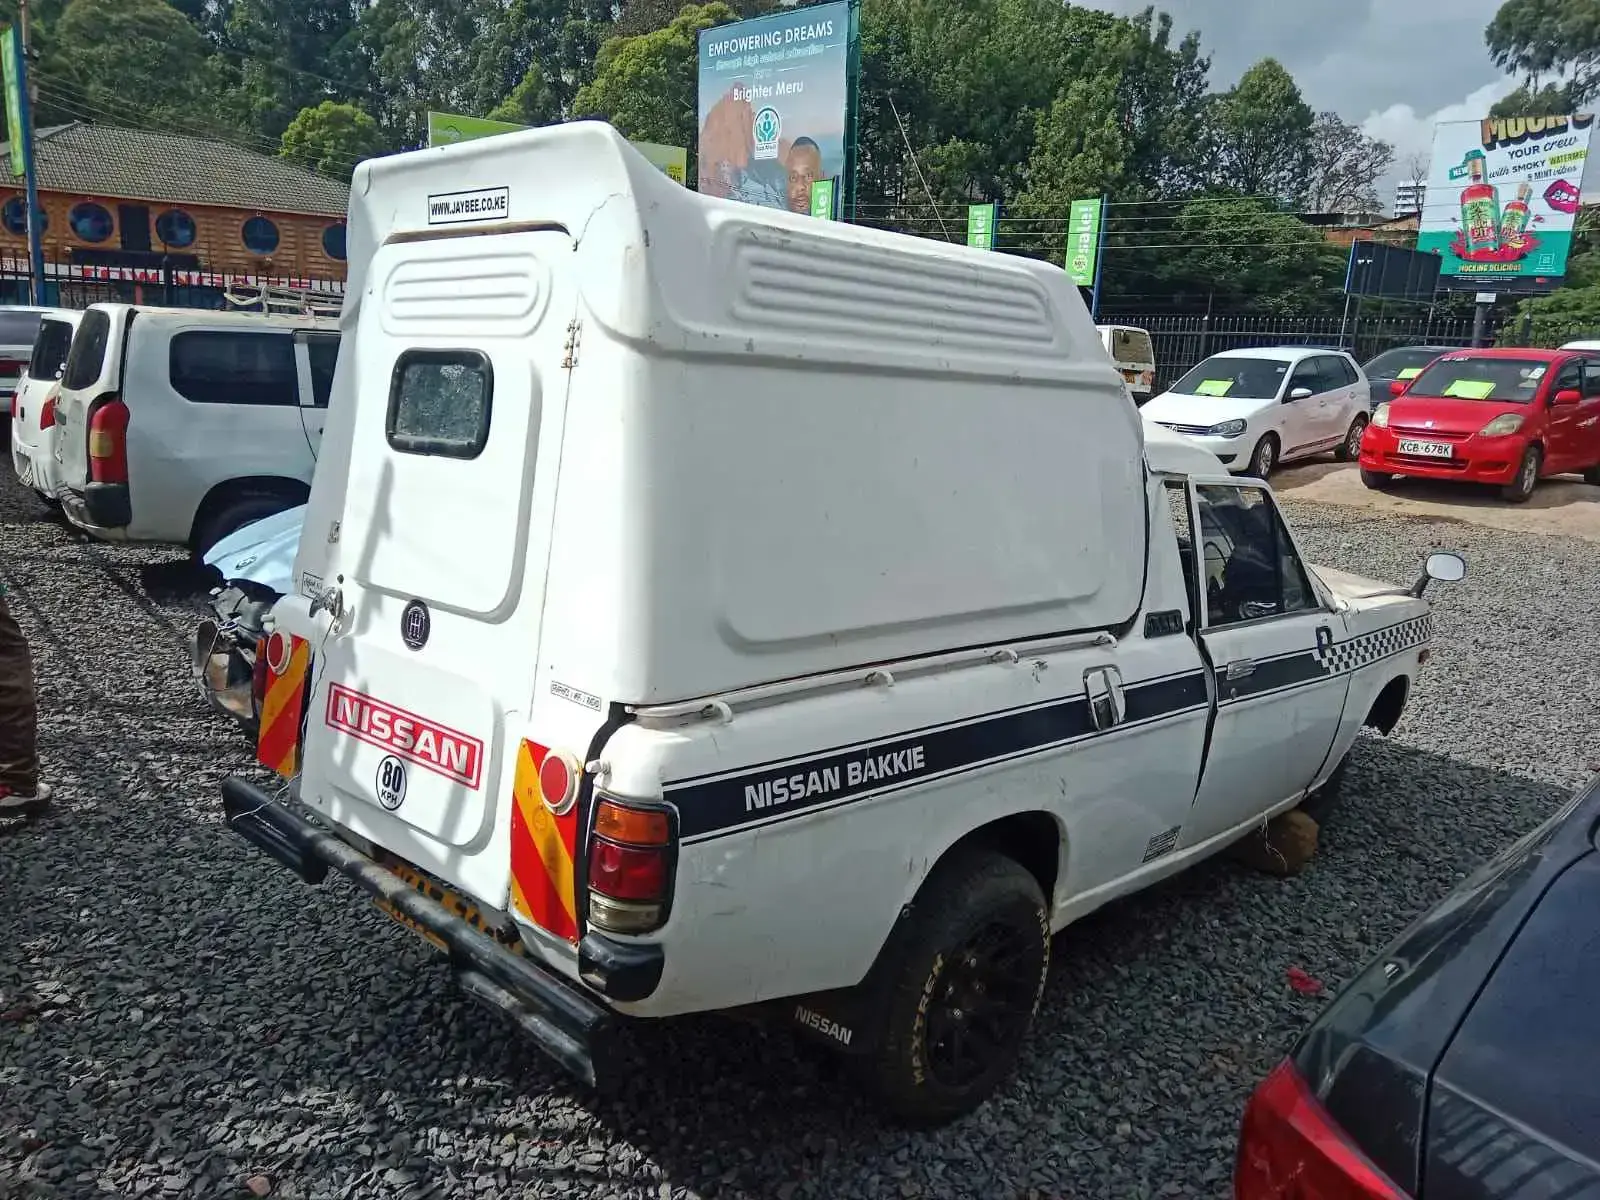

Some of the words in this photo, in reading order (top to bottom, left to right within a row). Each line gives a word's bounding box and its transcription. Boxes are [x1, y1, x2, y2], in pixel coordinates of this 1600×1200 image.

[708, 31, 781, 57] EMPOWERING
[785, 20, 833, 44] DREAMS
[733, 83, 772, 102] Brighter
[776, 80, 804, 97] Meru
[1508, 145, 1540, 160] YOUR
[1544, 136, 1577, 152] crew
[1489, 165, 1509, 179] with
[1512, 160, 1546, 174] SMOKY
[430, 196, 506, 216] WWW.JAYBEE.CO.KE
[1399, 441, 1419, 453] KCB
[1424, 444, 1451, 457] 678K
[337, 695, 468, 774] NISSAN
[382, 761, 403, 793] 80
[744, 766, 841, 812] NISSAN
[846, 745, 925, 786] BAKKIE
[381, 789, 398, 805] KPH
[794, 1005, 853, 1046] NISSAN
